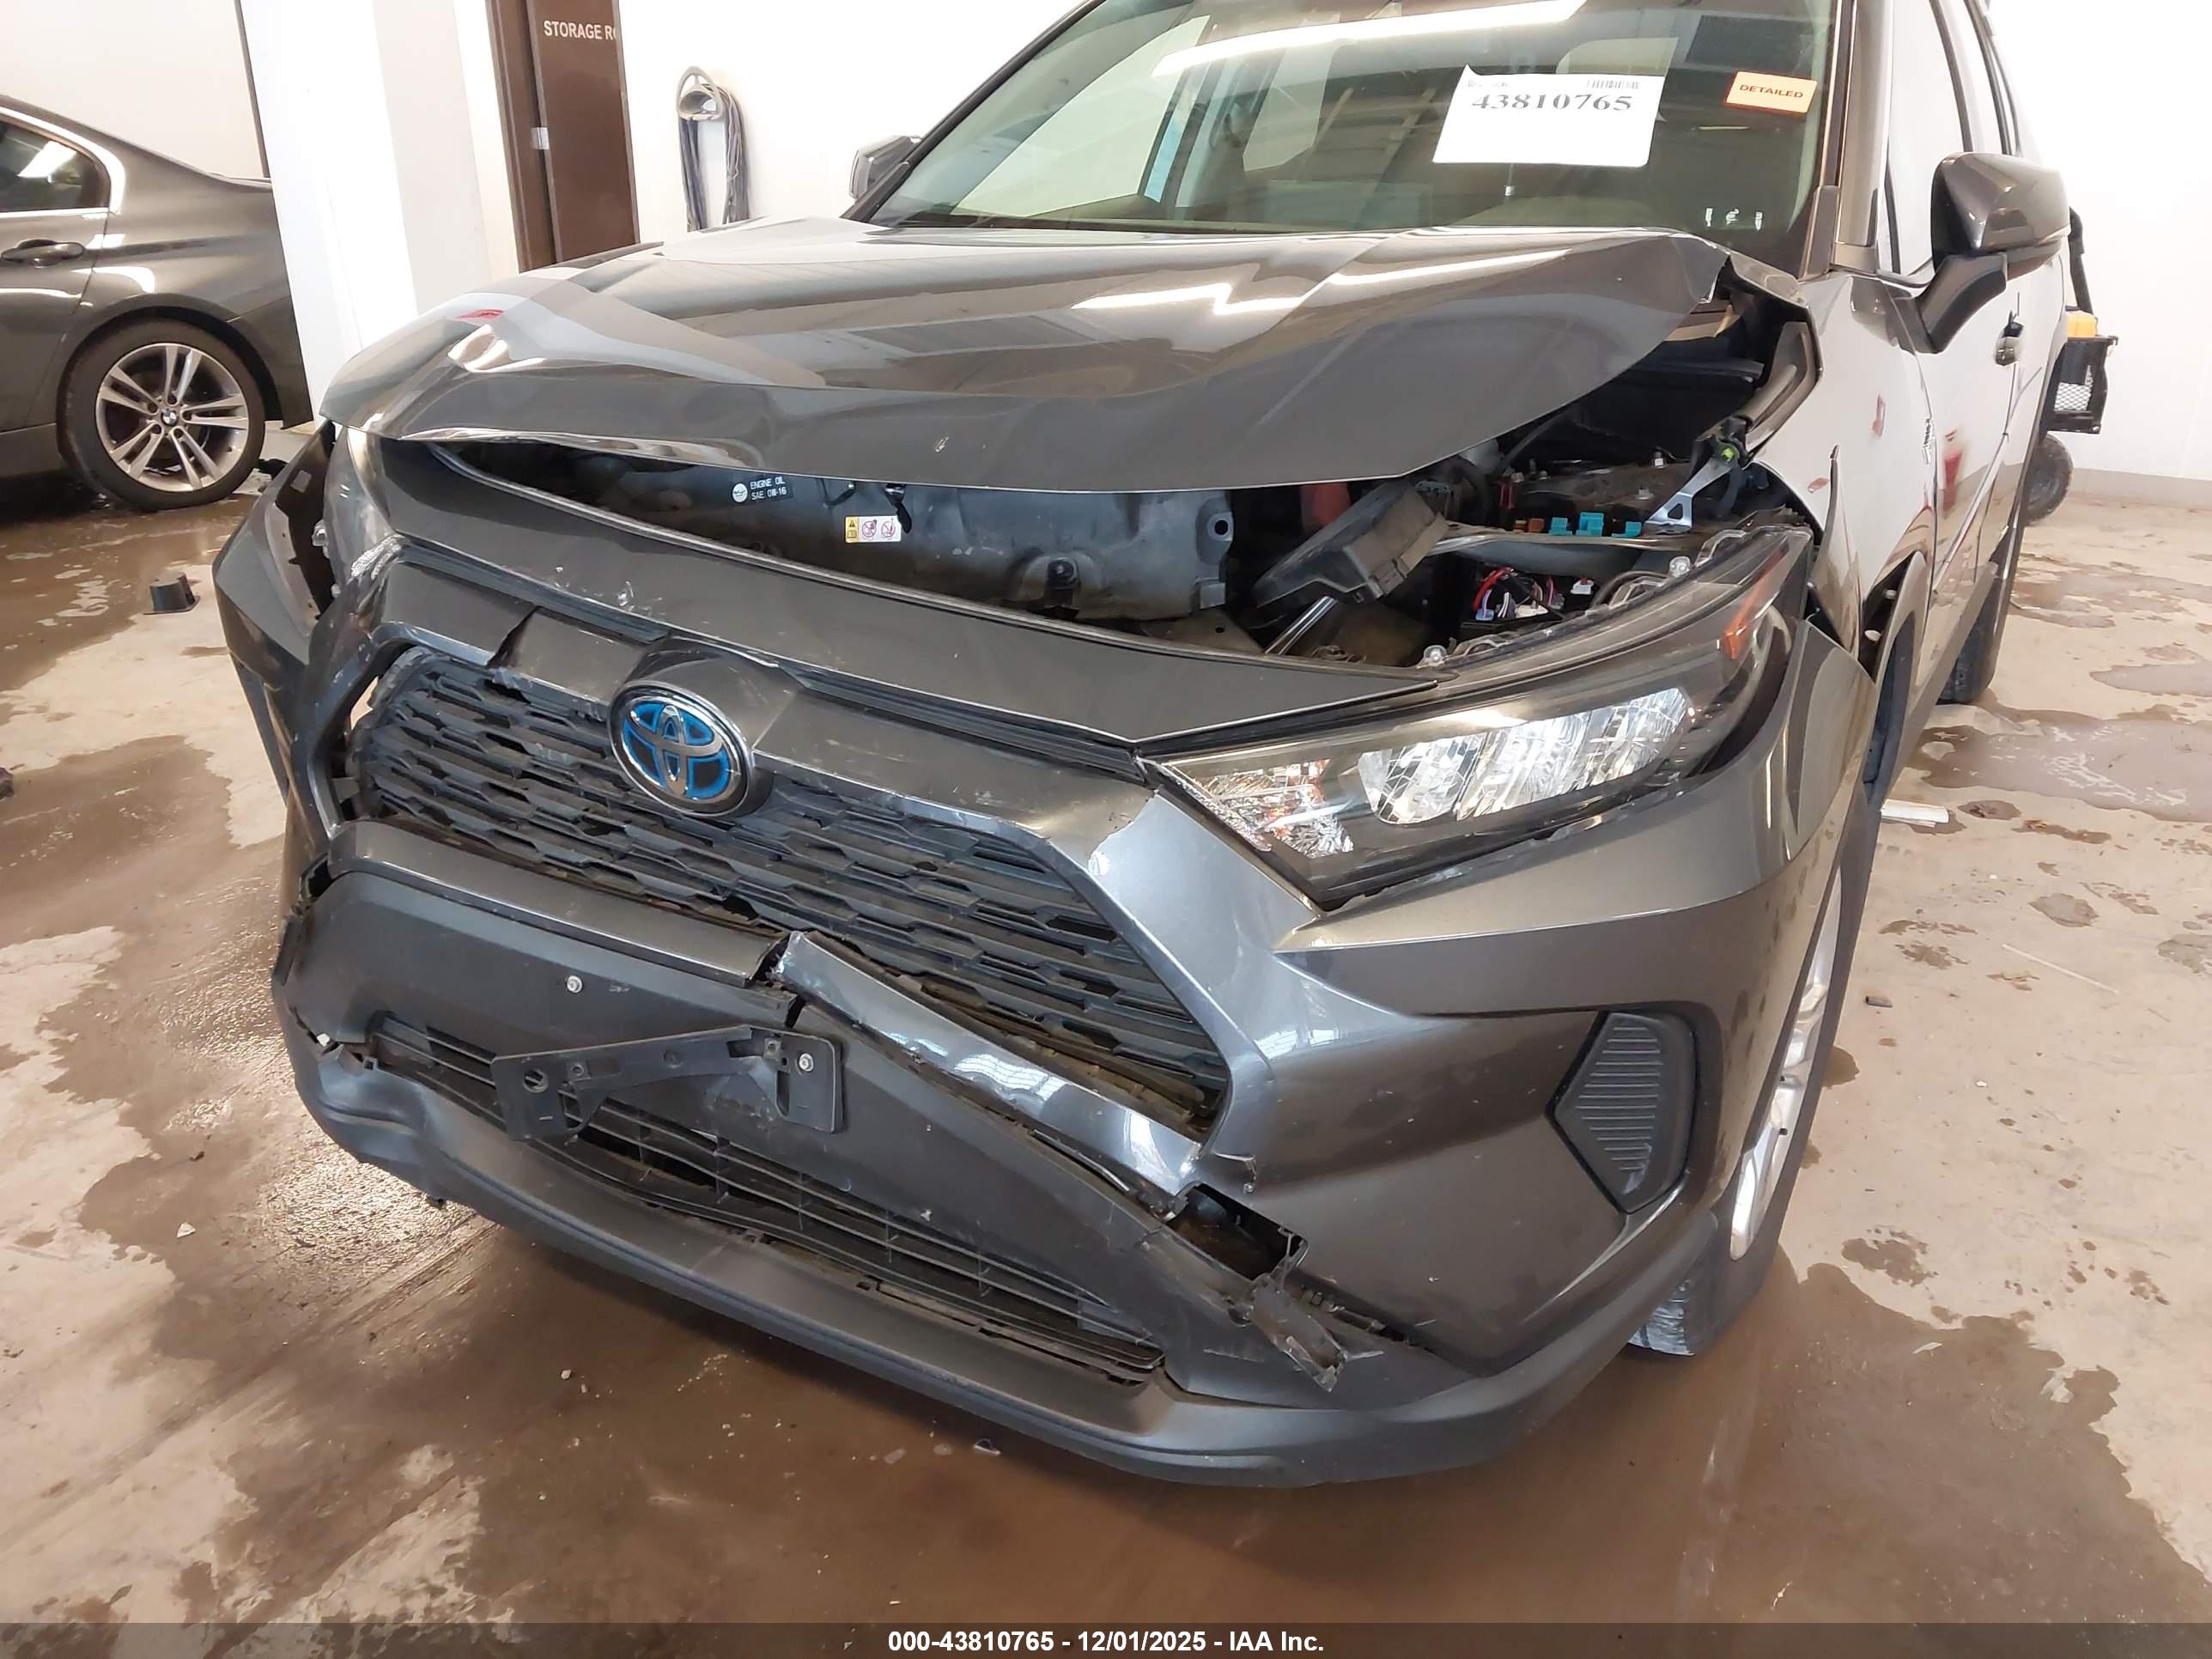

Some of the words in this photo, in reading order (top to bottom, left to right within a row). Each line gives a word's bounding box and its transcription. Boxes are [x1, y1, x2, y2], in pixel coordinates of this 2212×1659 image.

[544, 20, 603, 40] STORAGE
[1740, 84, 1804, 98] DETAILED
[1472, 94, 1633, 112] 43810765
[750, 477, 773, 489] ENGINE
[775, 476, 786, 485] OIL
[751, 490, 765, 501] SAE
